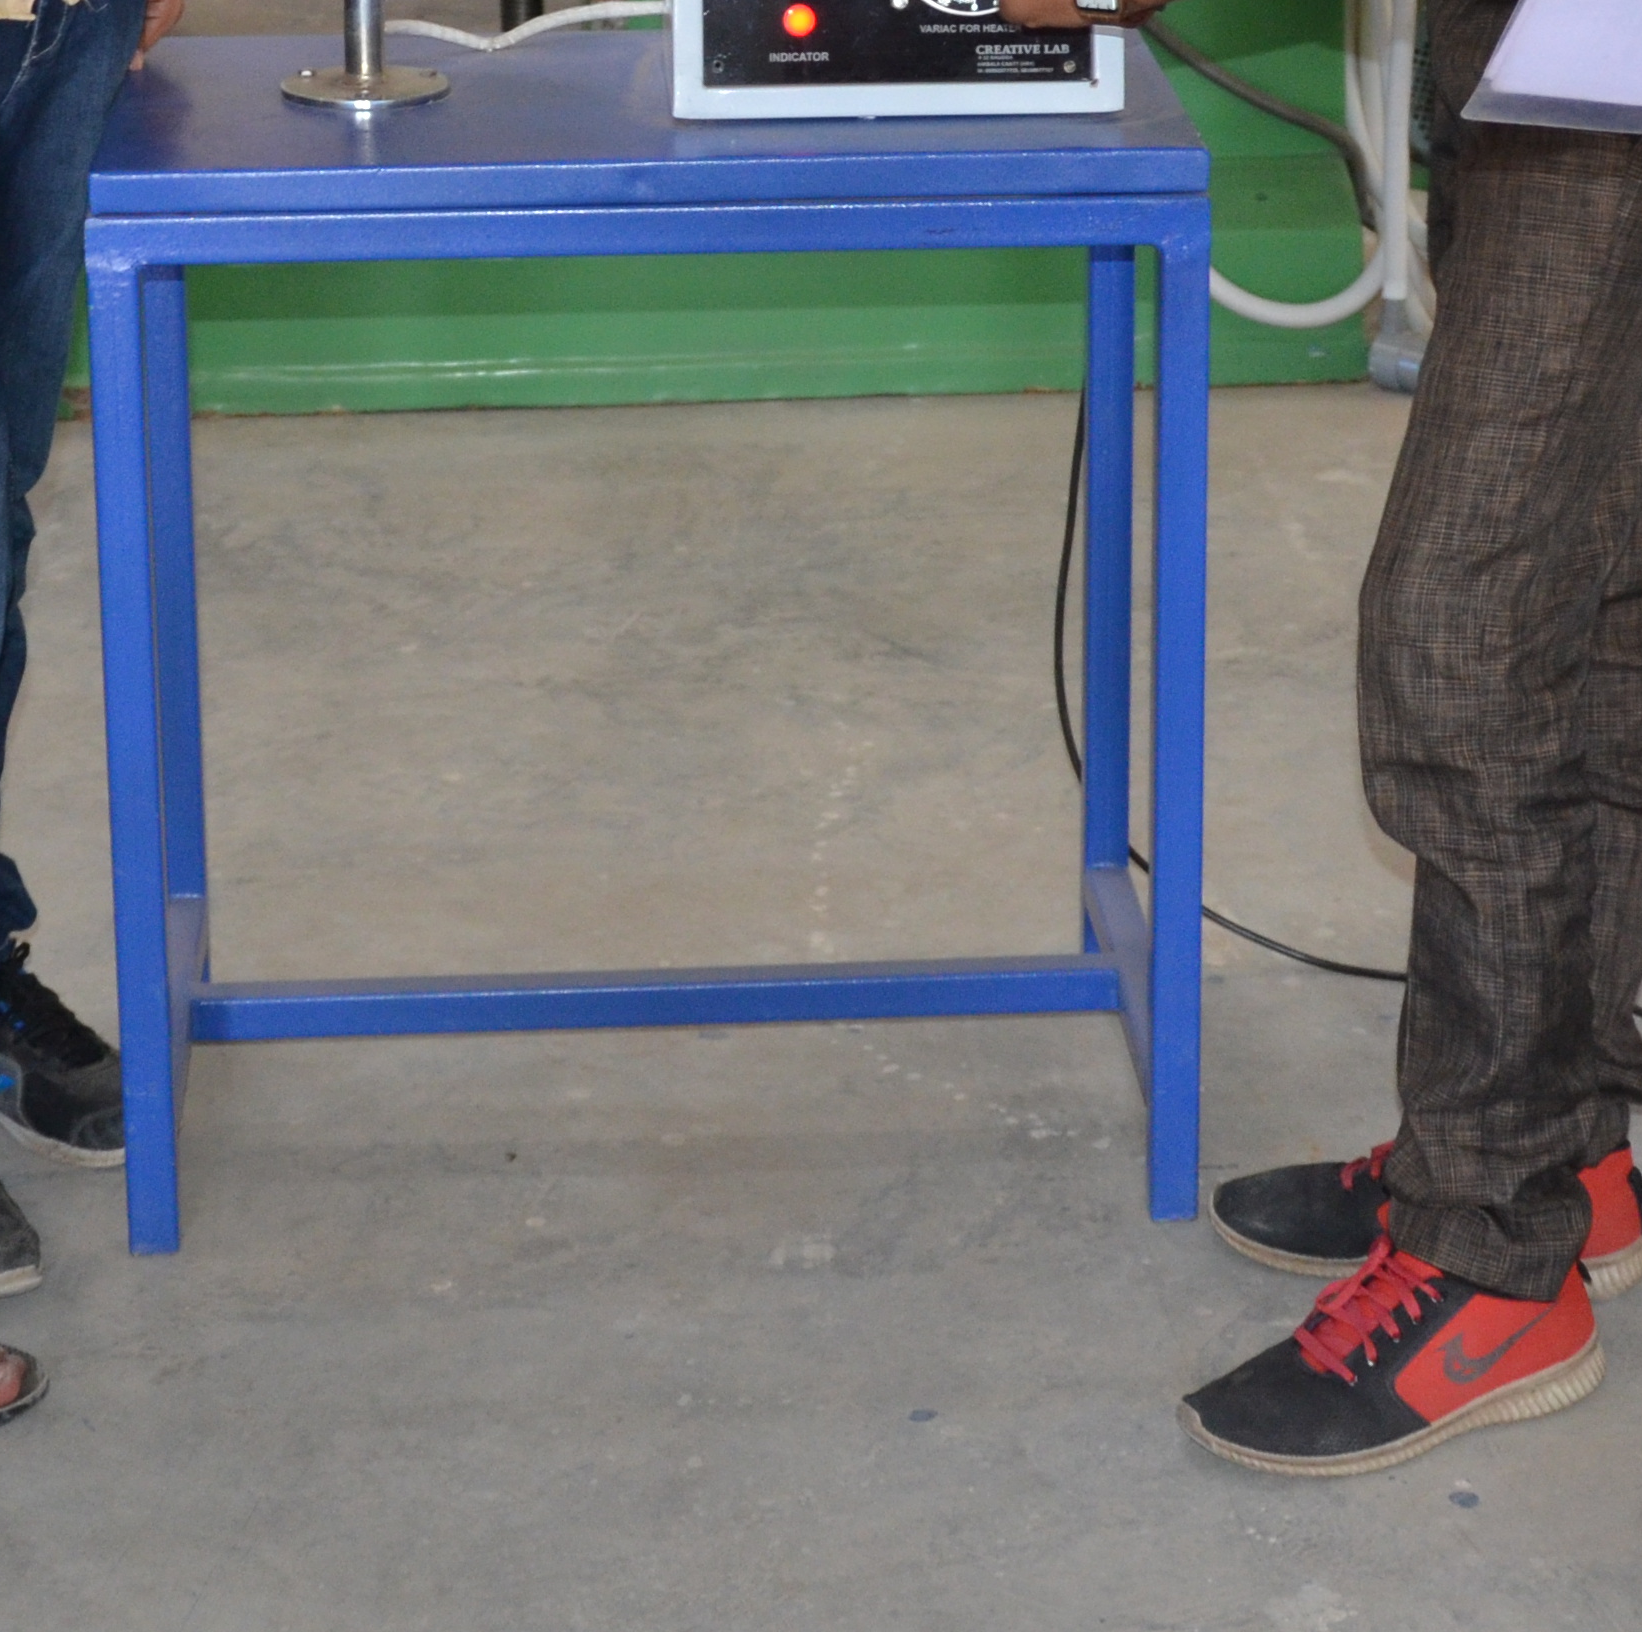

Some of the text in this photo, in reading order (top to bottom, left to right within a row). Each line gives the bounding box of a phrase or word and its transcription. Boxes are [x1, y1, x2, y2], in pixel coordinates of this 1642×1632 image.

[919, 24, 957, 33] VARIAC
[959, 24, 981, 32] FOR
[975, 44, 1070, 55] CREATIVE LAB
[769, 52, 829, 62] INDICATOR
